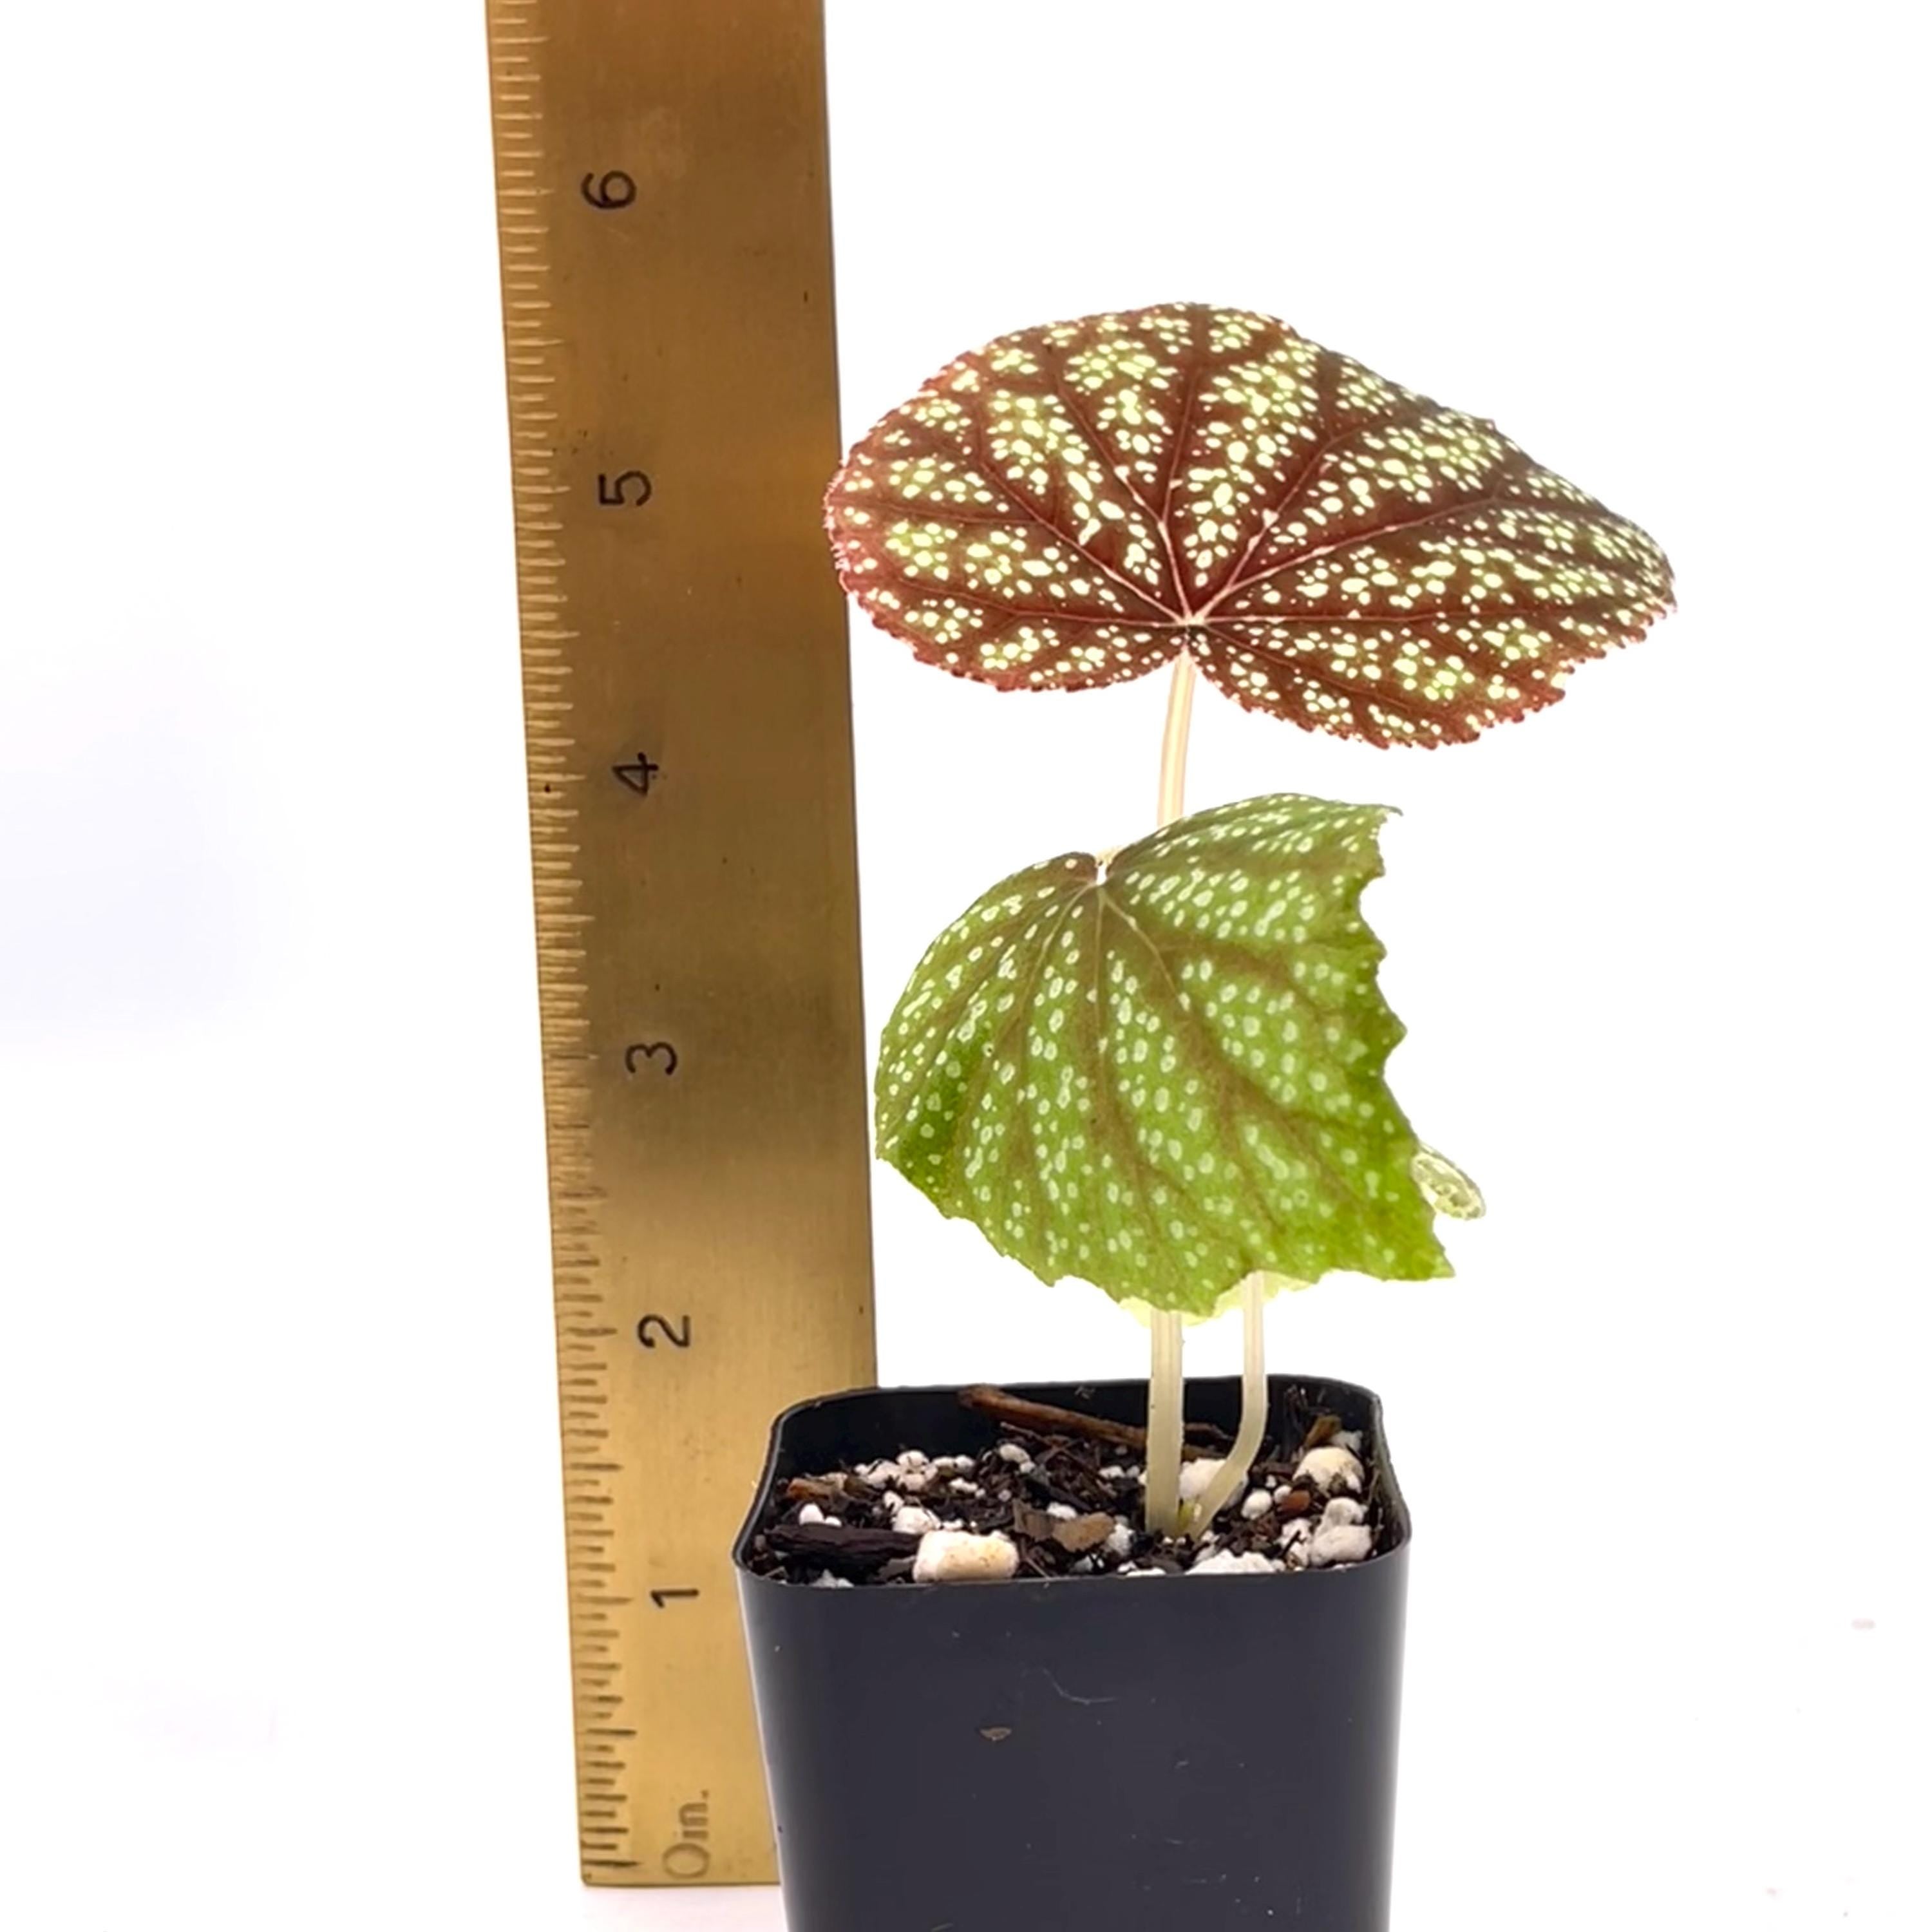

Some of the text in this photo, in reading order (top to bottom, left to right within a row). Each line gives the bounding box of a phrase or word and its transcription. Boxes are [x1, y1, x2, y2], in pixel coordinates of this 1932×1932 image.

[581, 170, 638, 209] 6
[598, 470, 652, 506] 5
[612, 752, 659, 797] 4
[625, 1042, 677, 1075] 3
[638, 1314, 690, 1349] 2
[650, 1589, 699, 1609] 1
